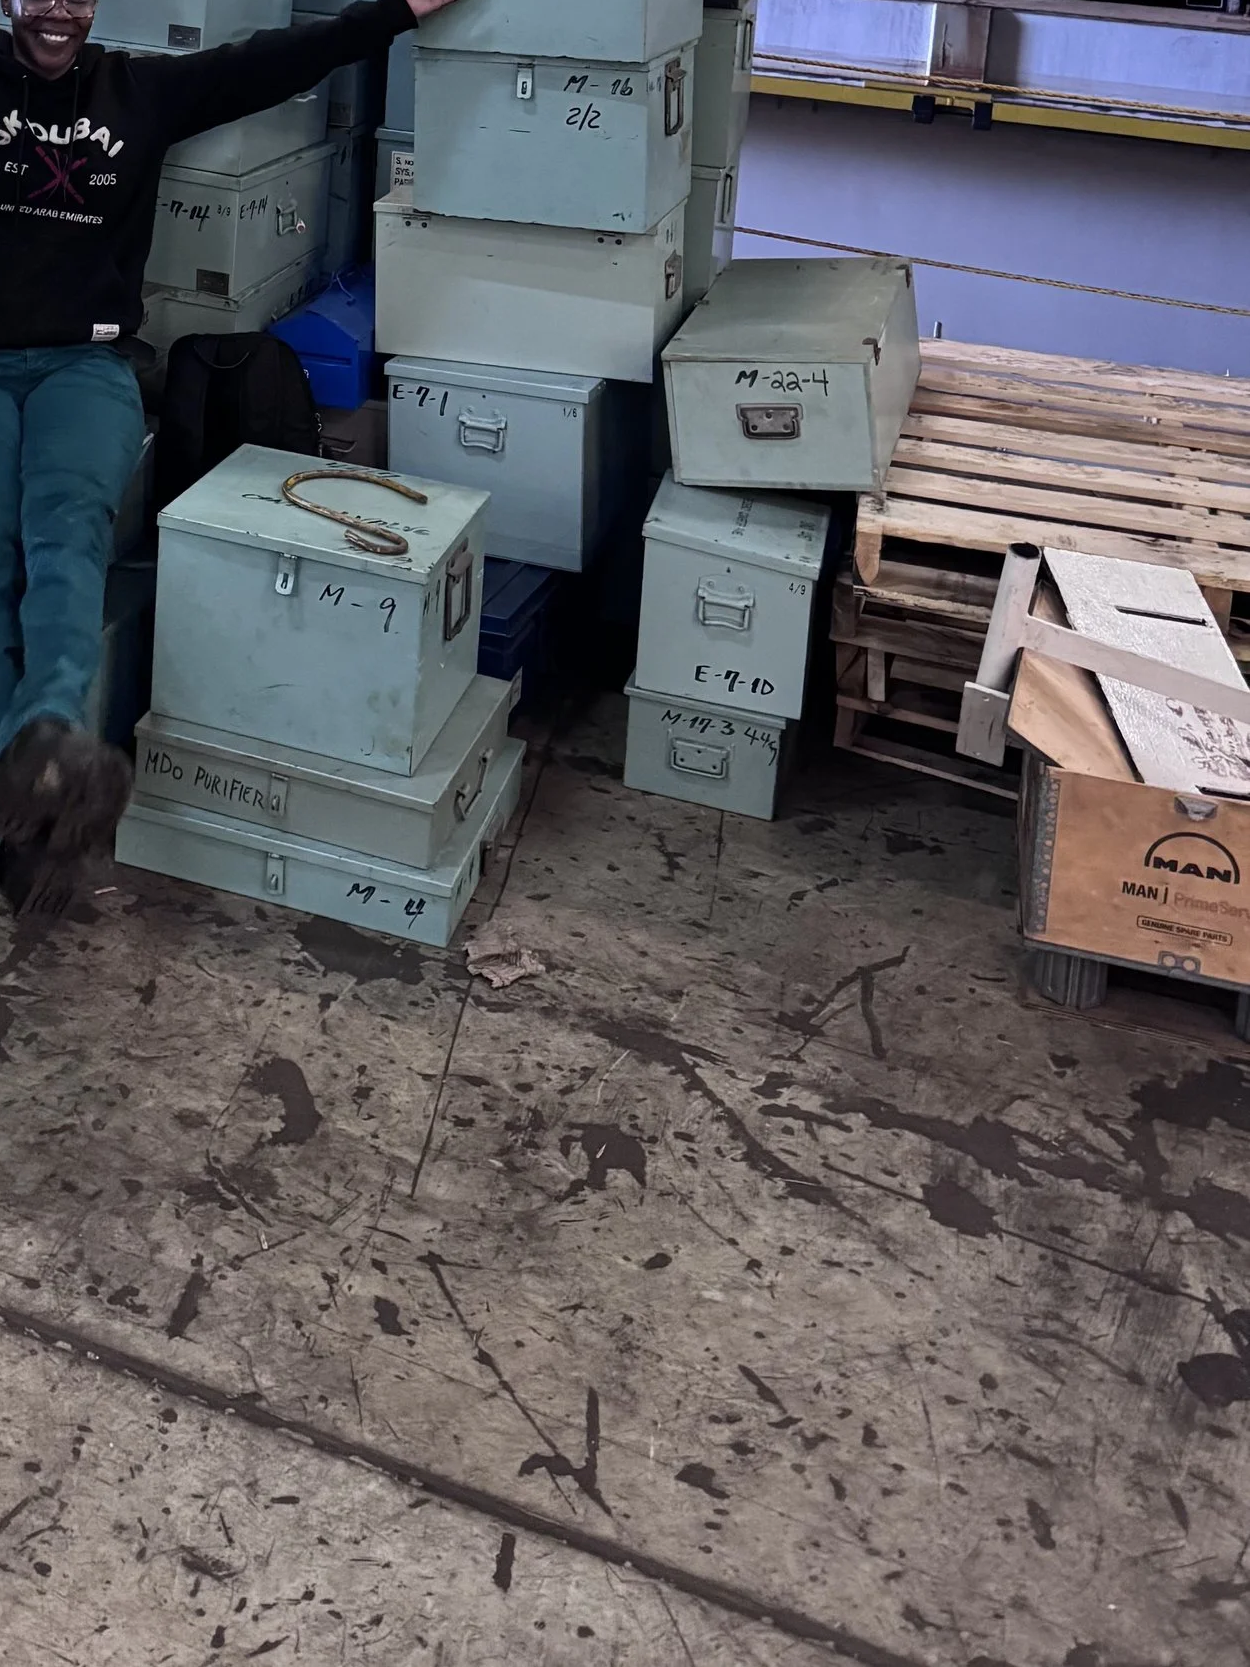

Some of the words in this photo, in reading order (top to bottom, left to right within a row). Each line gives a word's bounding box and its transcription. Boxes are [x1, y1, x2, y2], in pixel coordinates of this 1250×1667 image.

[565, 102, 602, 132] 2/2
[4, 161, 29, 176] EST
[89, 173, 117, 186] 2005
[33, 207, 59, 219] ARAB
[59, 211, 104, 225] EMIRATES
[157, 195, 211, 232] -7-14
[735, 368, 830, 397] M-22-4
[392, 382, 449, 416] E-7-1
[788, 582, 807, 596] 4/9
[661, 709, 735, 737] M-17-3
[194, 765, 266, 810] PURIFIER
[1152, 855, 1232, 884] MAN
[1121, 881, 1159, 901] MAN
[1141, 918, 1175, 932] GENUINE
[1175, 925, 1201, 937] SPARE
[1202, 931, 1228, 943] PARTS
